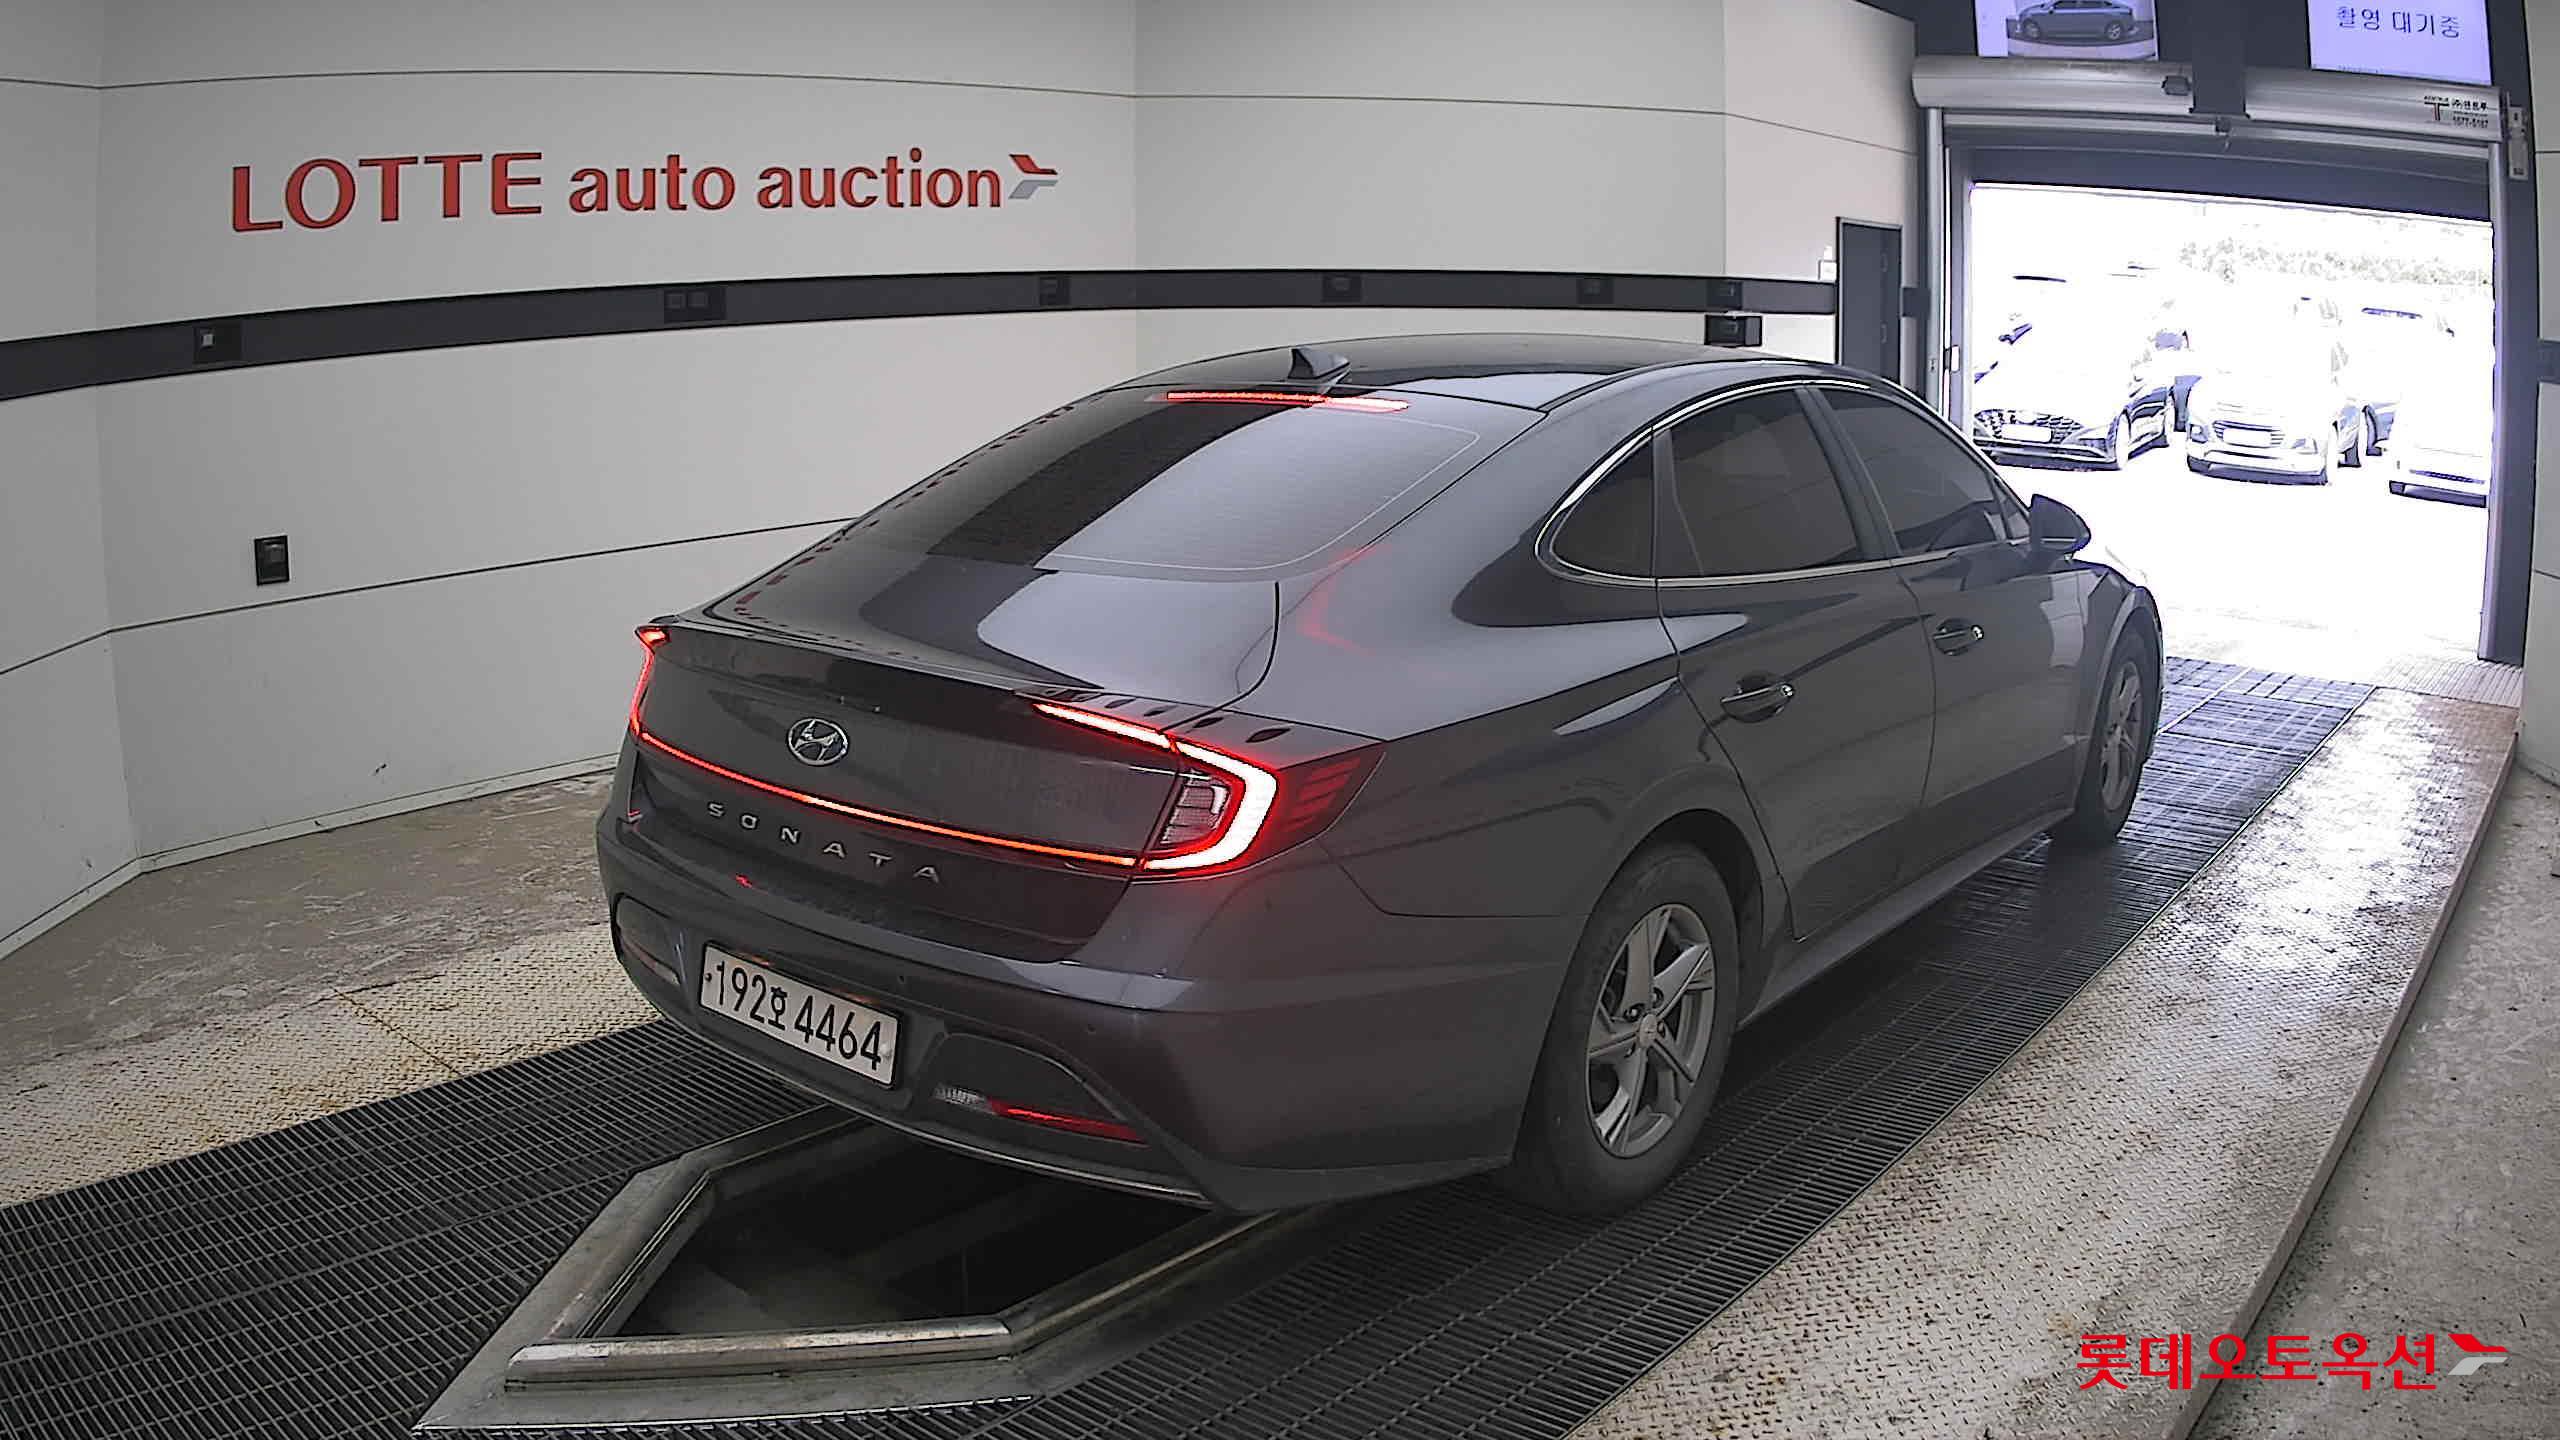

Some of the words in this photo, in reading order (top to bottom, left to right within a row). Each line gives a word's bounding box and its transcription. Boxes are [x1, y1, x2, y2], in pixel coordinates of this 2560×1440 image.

[2337, 6, 2380, 31] 촬영
[2392, 11, 2460, 39] 대기중
[232, 152, 542, 233] LOTTE
[568, 154, 736, 213] auto
[757, 147, 1002, 209] auction
[708, 802, 940, 884] SONATA
[716, 960, 788, 1031] 192호
[794, 995, 882, 1070] 4464
